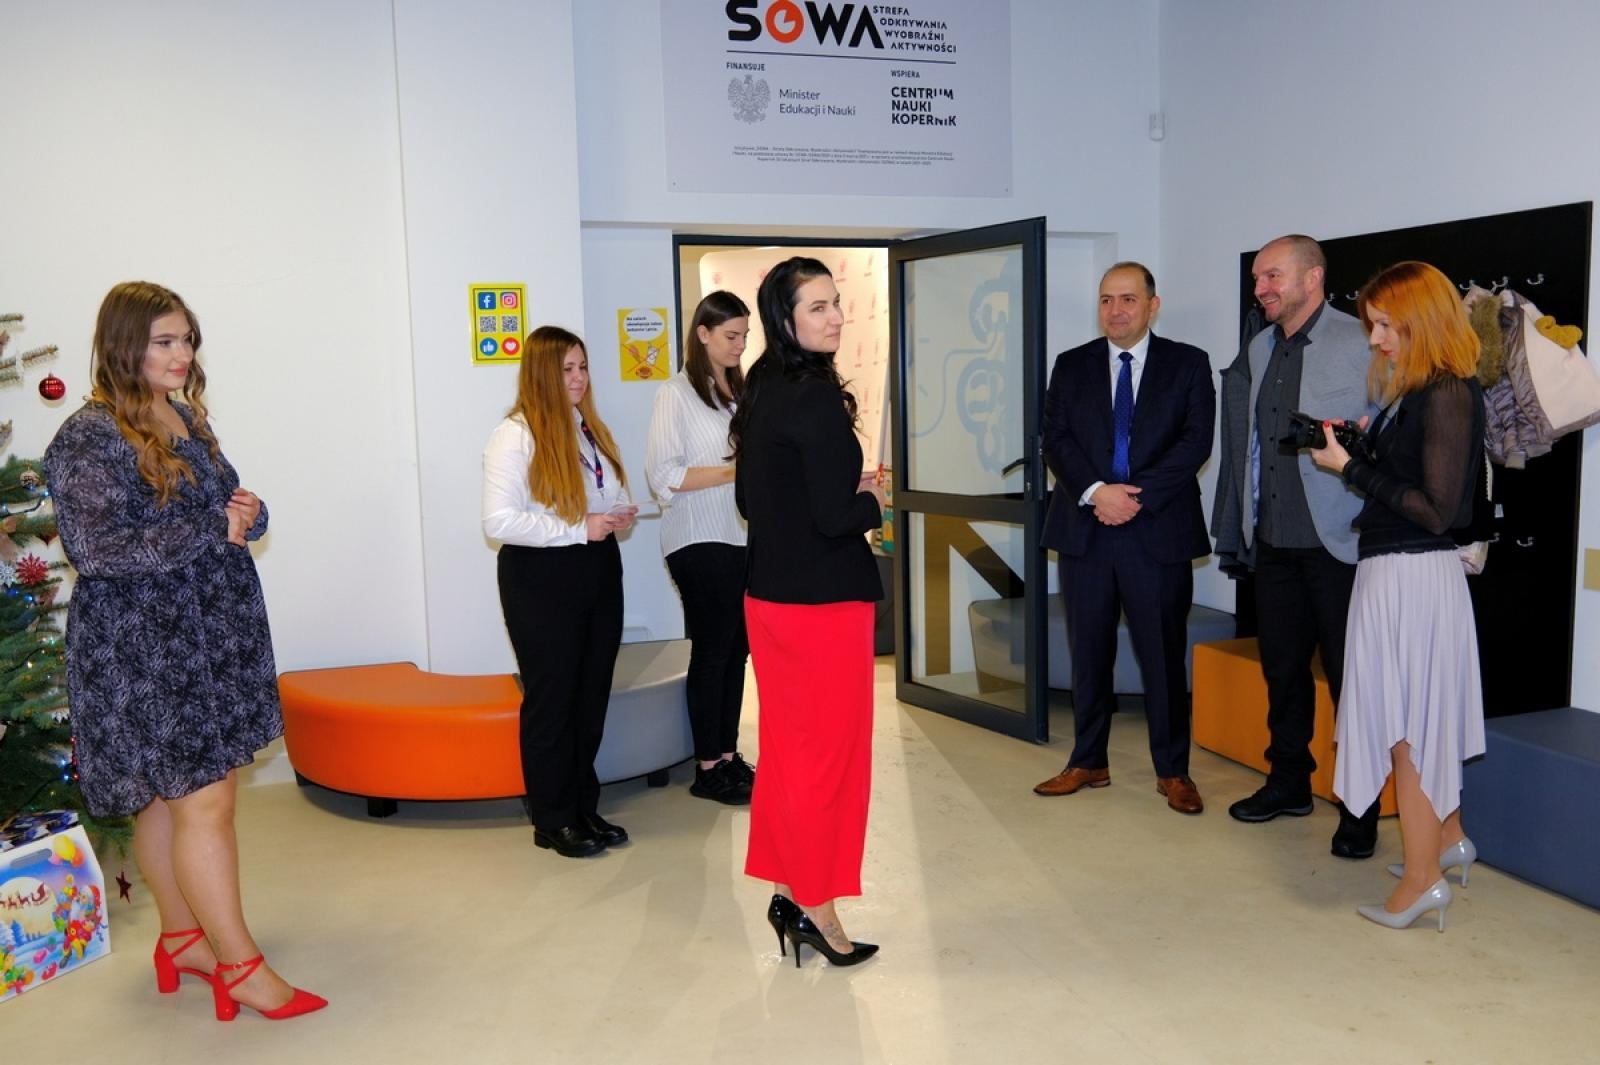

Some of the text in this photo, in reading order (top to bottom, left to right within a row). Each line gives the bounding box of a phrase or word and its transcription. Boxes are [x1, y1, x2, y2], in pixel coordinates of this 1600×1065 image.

[873, 5, 910, 16] STREFA
[725, 0, 885, 49] SOWA
[880, 17, 948, 30] ODKRYWANIA
[884, 29, 945, 41] WYOBRAŹNI
[890, 42, 957, 53] AKTYWNOŚCI
[726, 62, 766, 72] FINANSUJE
[891, 70, 921, 79] WSPIERA
[779, 88, 821, 101] Minister
[779, 103, 821, 117] Edukacji
[827, 105, 857, 116] Nauki
[891, 99, 932, 112] NAUKI
[891, 112, 957, 126] KOPERNIK
